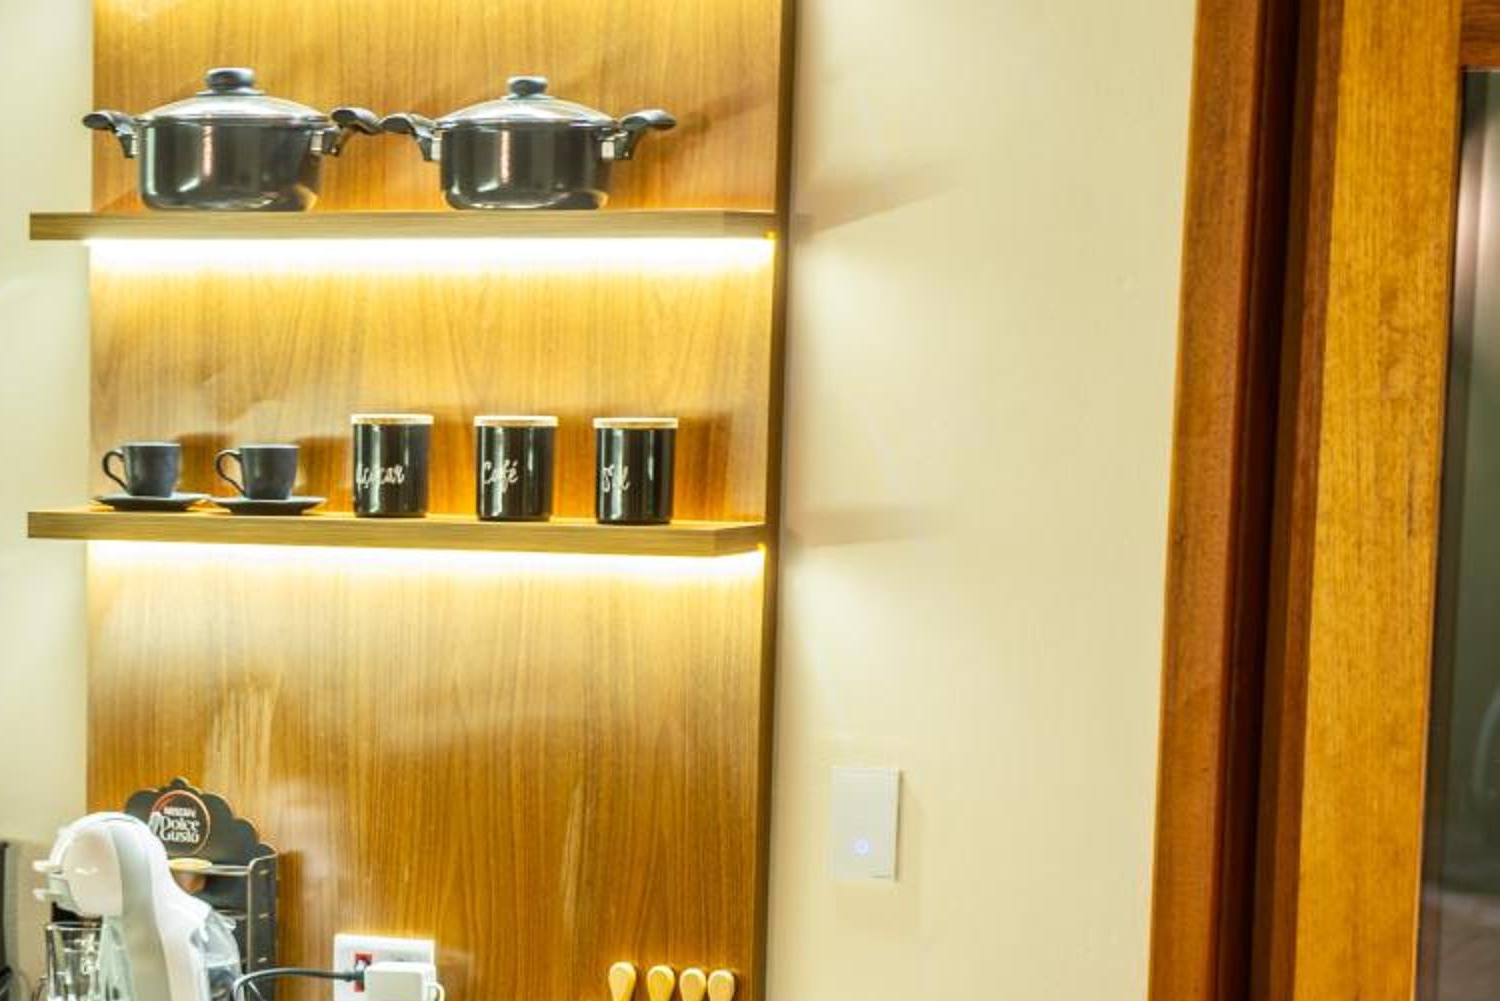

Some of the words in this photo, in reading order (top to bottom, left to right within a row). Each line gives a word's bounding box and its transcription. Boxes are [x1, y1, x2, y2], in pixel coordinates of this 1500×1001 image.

[602, 464, 631, 493] Sl
[160, 816, 201, 832] Dolce
[160, 830, 201, 843] Gusto
